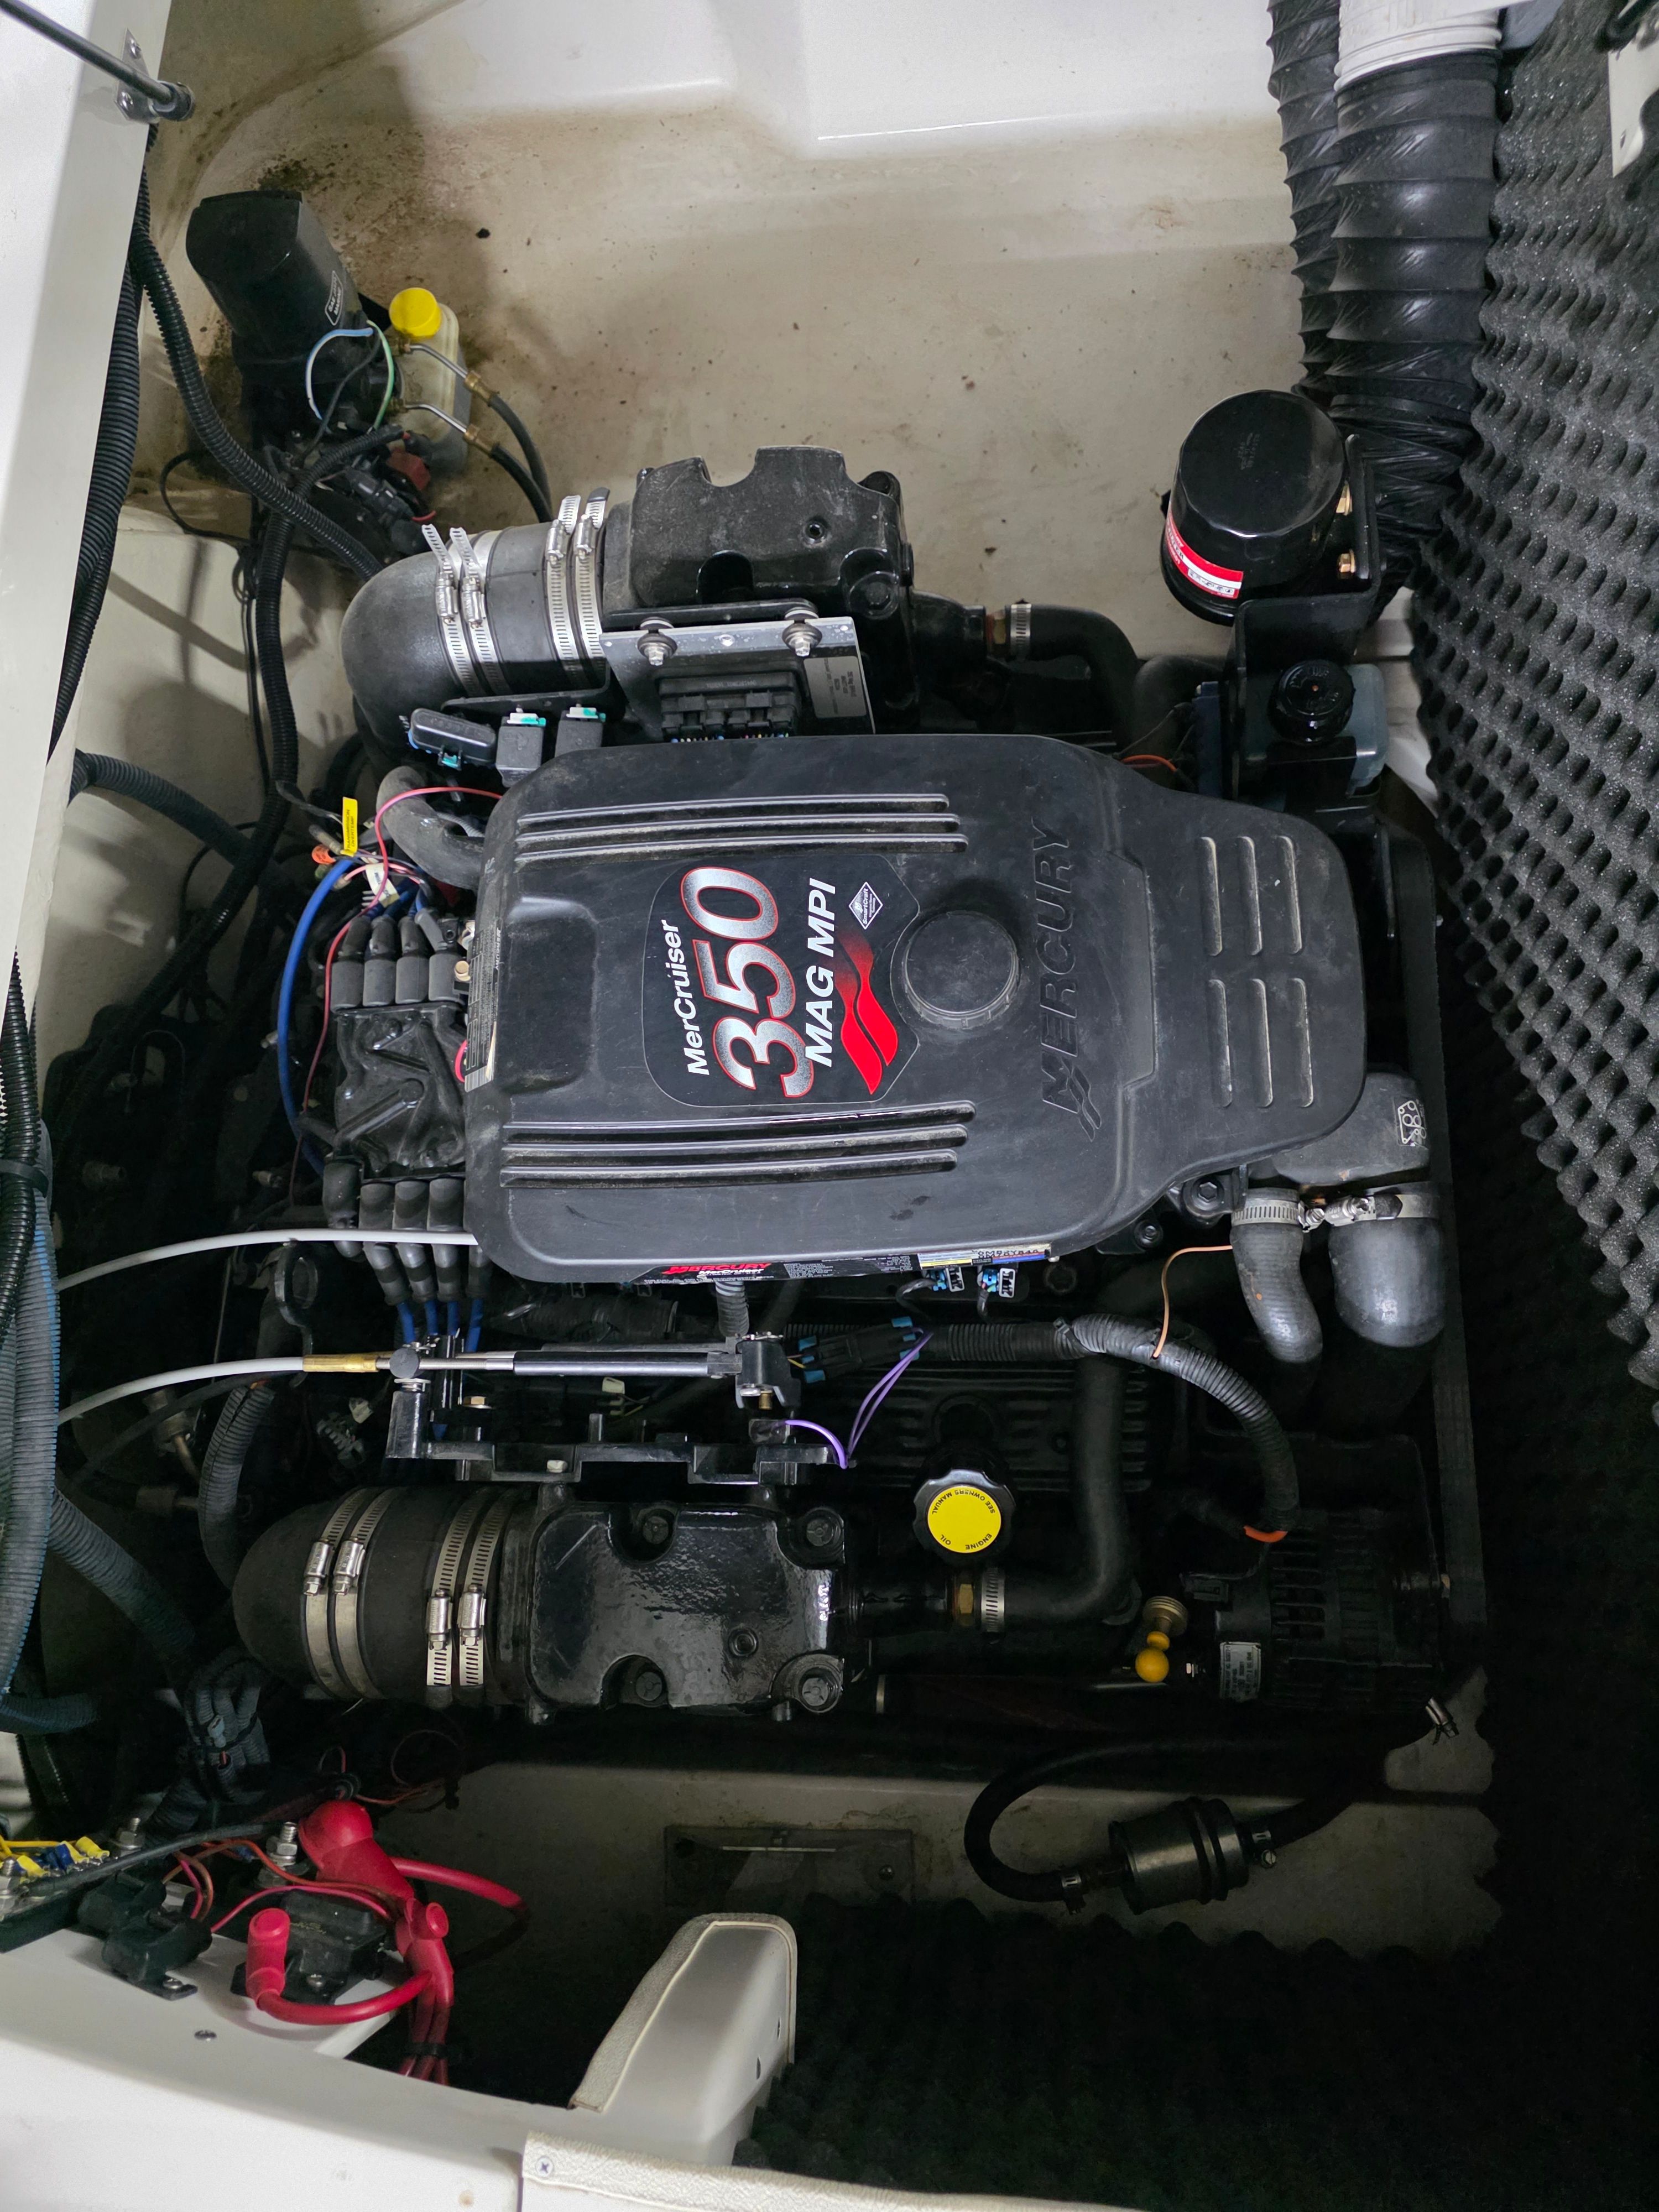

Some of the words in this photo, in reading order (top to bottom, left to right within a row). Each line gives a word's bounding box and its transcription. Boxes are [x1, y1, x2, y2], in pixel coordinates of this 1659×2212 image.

[807, 878, 836, 957] MPI
[1031, 816, 1081, 1114] MERCURY
[681, 866, 814, 1098] 350
[661, 920, 709, 1075] MerCruiser
[804, 964, 834, 1067] MAG
[661, 1262, 772, 1275] MERCURY
[932, 1491, 952, 1515] MANUAL
[954, 1489, 985, 1501] OWNERS
[985, 1500, 995, 1514] SEE
[940, 1534, 952, 1546] OIL
[965, 1533, 993, 1550] ENGINE
